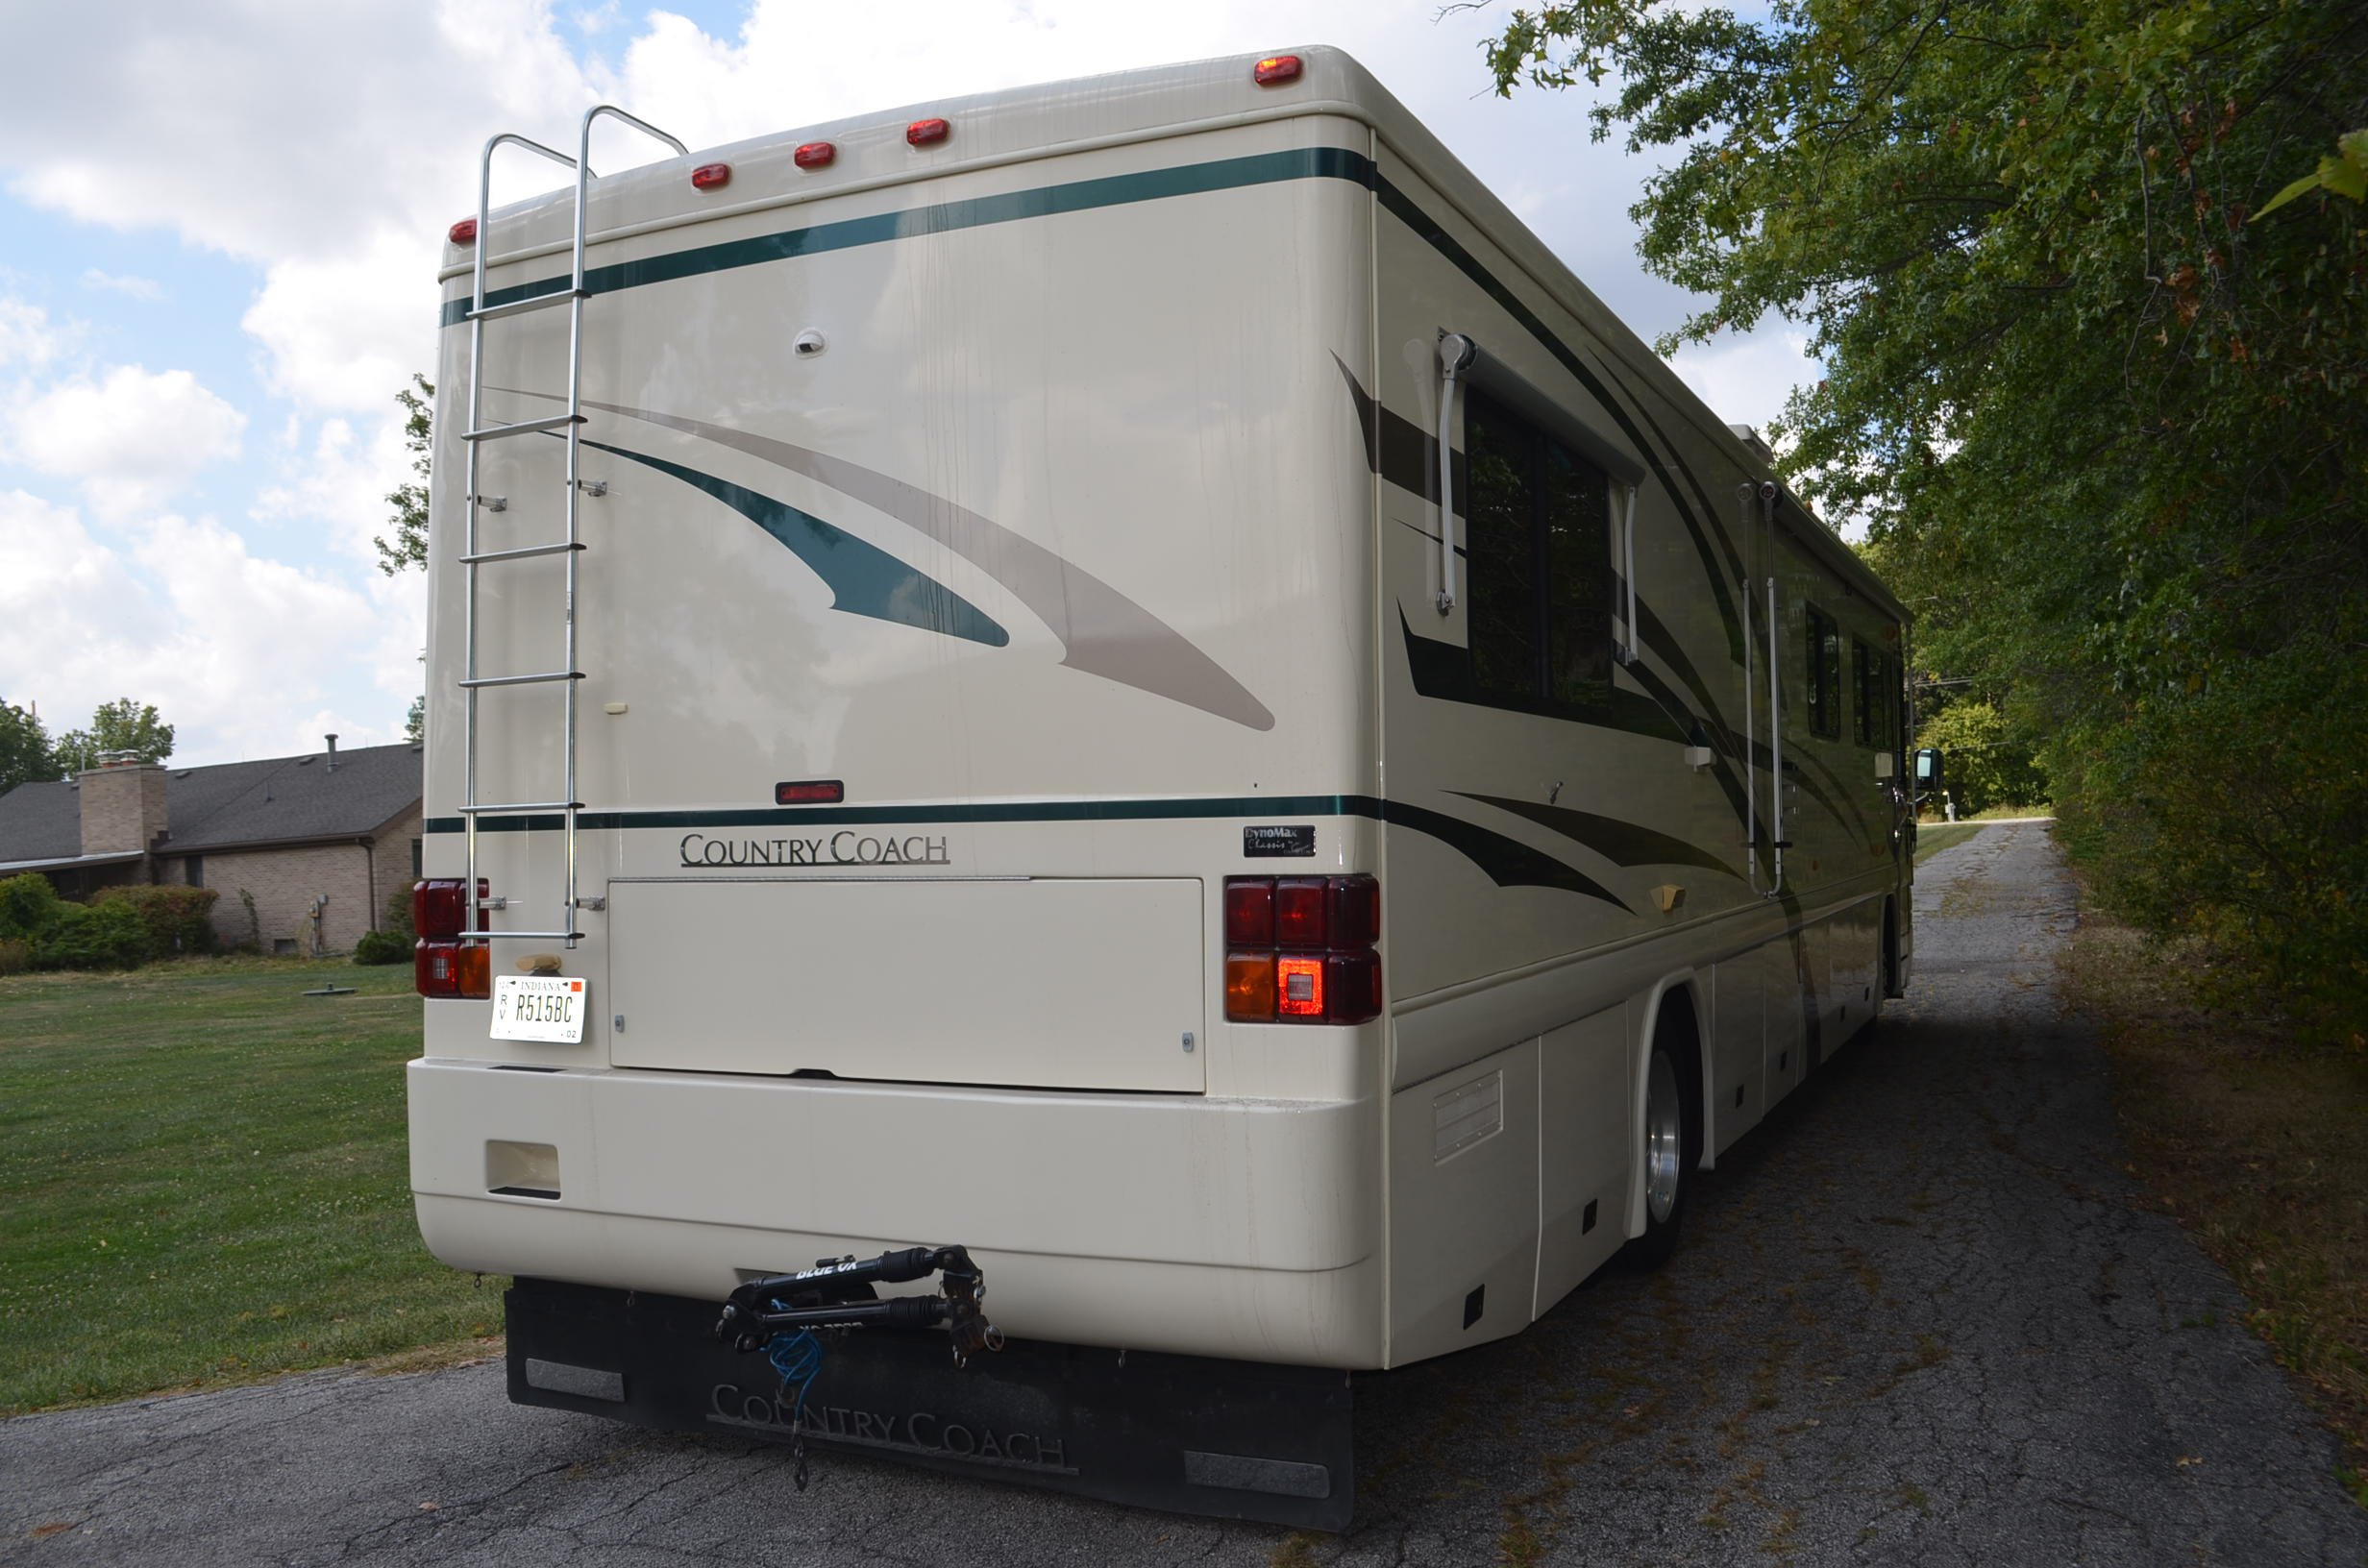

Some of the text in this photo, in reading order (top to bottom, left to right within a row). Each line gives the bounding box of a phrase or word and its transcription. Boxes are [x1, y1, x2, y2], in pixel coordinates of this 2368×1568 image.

[1245, 827, 1298, 839] DynoMax
[680, 830, 947, 865] COUNTRY COACH
[521, 981, 560, 991] INDIANA
[516, 994, 573, 1022] R515BC
[907, 1412, 1067, 1469] COACH
